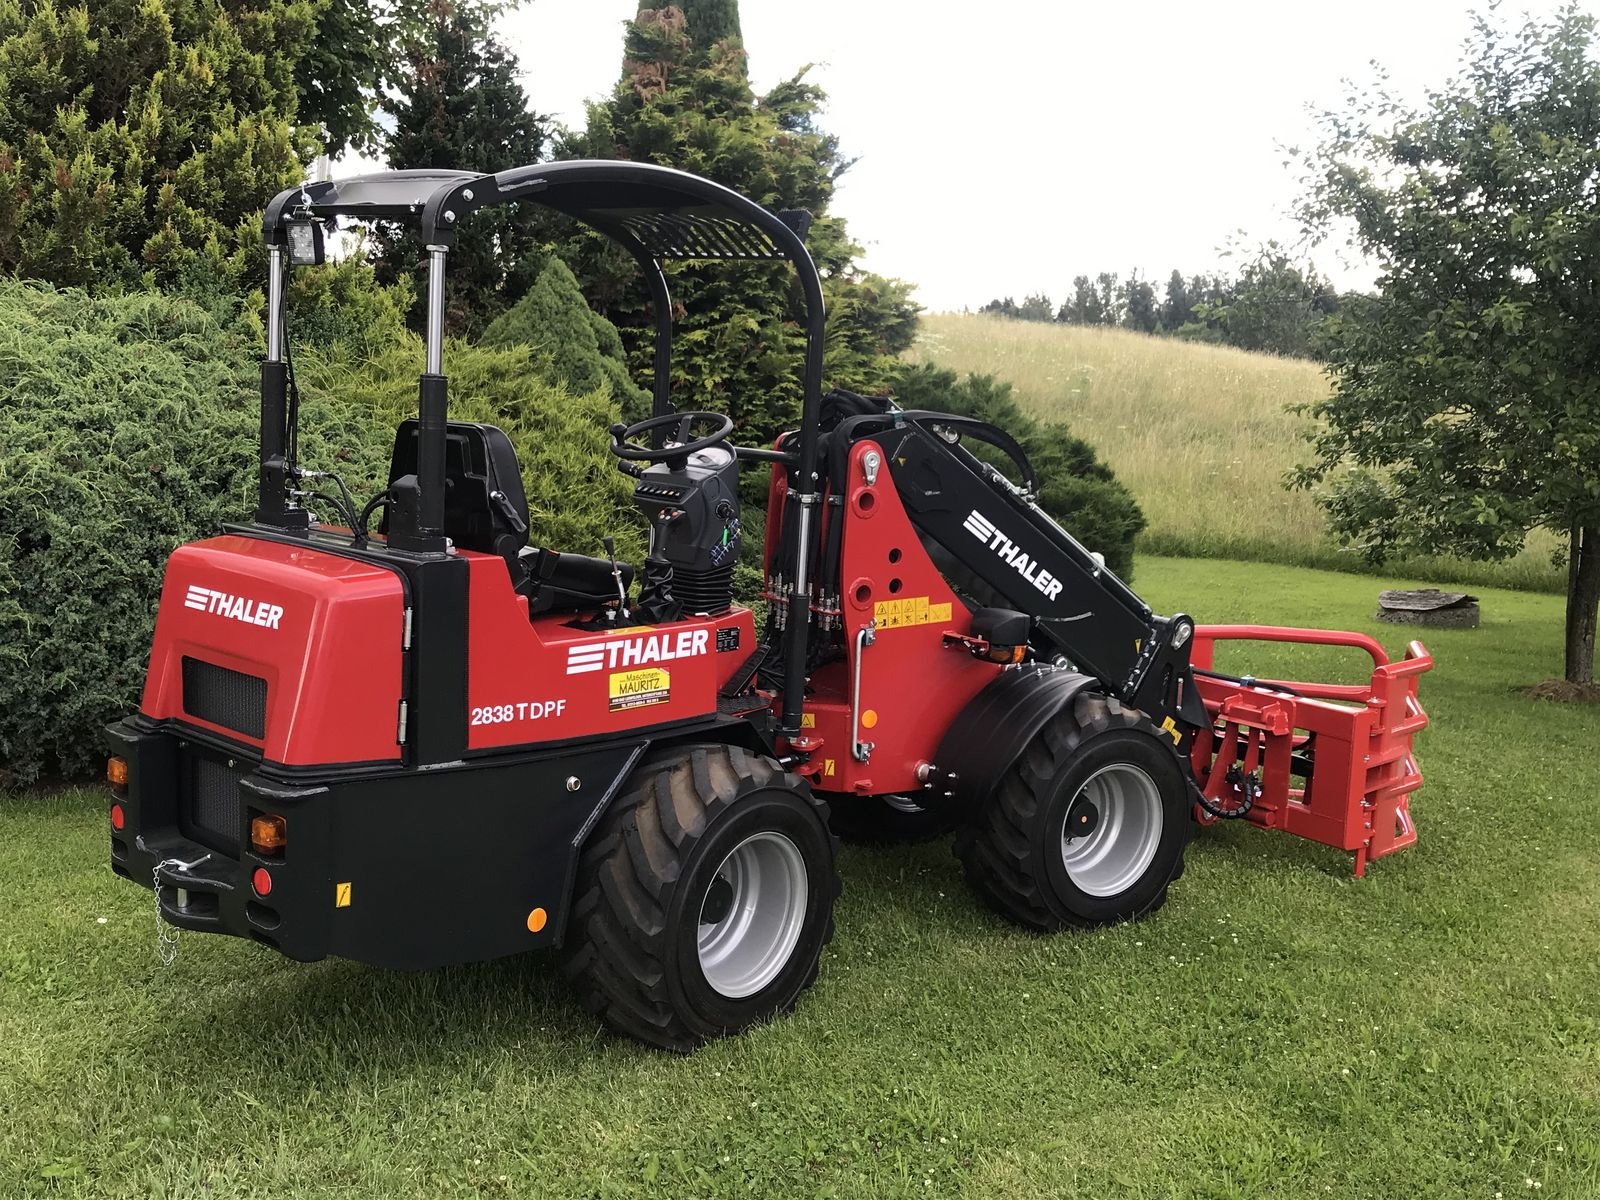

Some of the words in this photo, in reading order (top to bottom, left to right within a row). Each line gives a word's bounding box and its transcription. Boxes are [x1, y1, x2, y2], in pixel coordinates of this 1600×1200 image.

[988, 528, 1064, 602] THALER
[208, 589, 285, 630] THALER
[605, 629, 709, 669] THALER
[619, 678, 660, 695] MAURITZ
[471, 704, 514, 726] 2838
